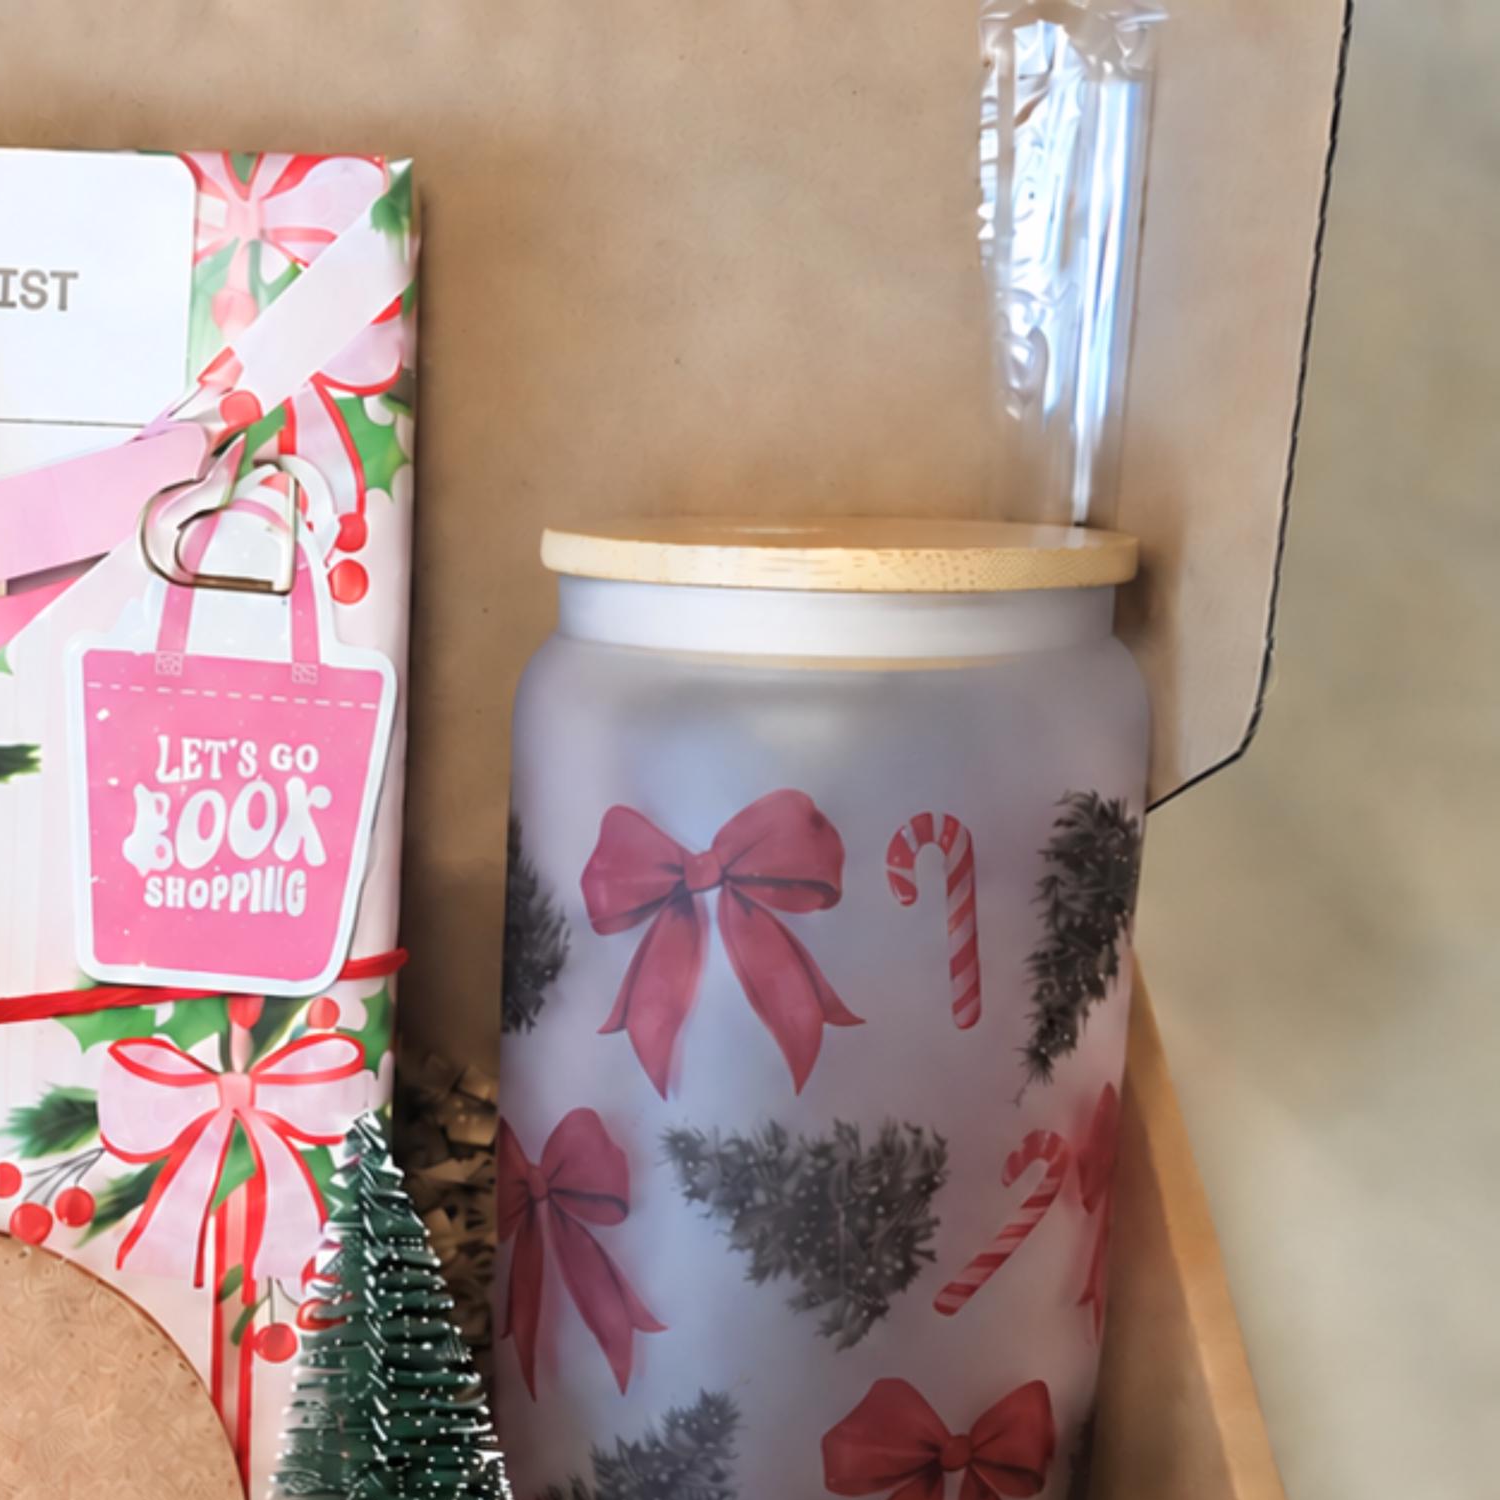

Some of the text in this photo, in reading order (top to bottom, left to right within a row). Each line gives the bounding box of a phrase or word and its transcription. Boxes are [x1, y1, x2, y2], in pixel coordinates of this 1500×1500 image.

[156, 735, 319, 783] LET'S GO
[122, 776, 332, 877] BOOK
